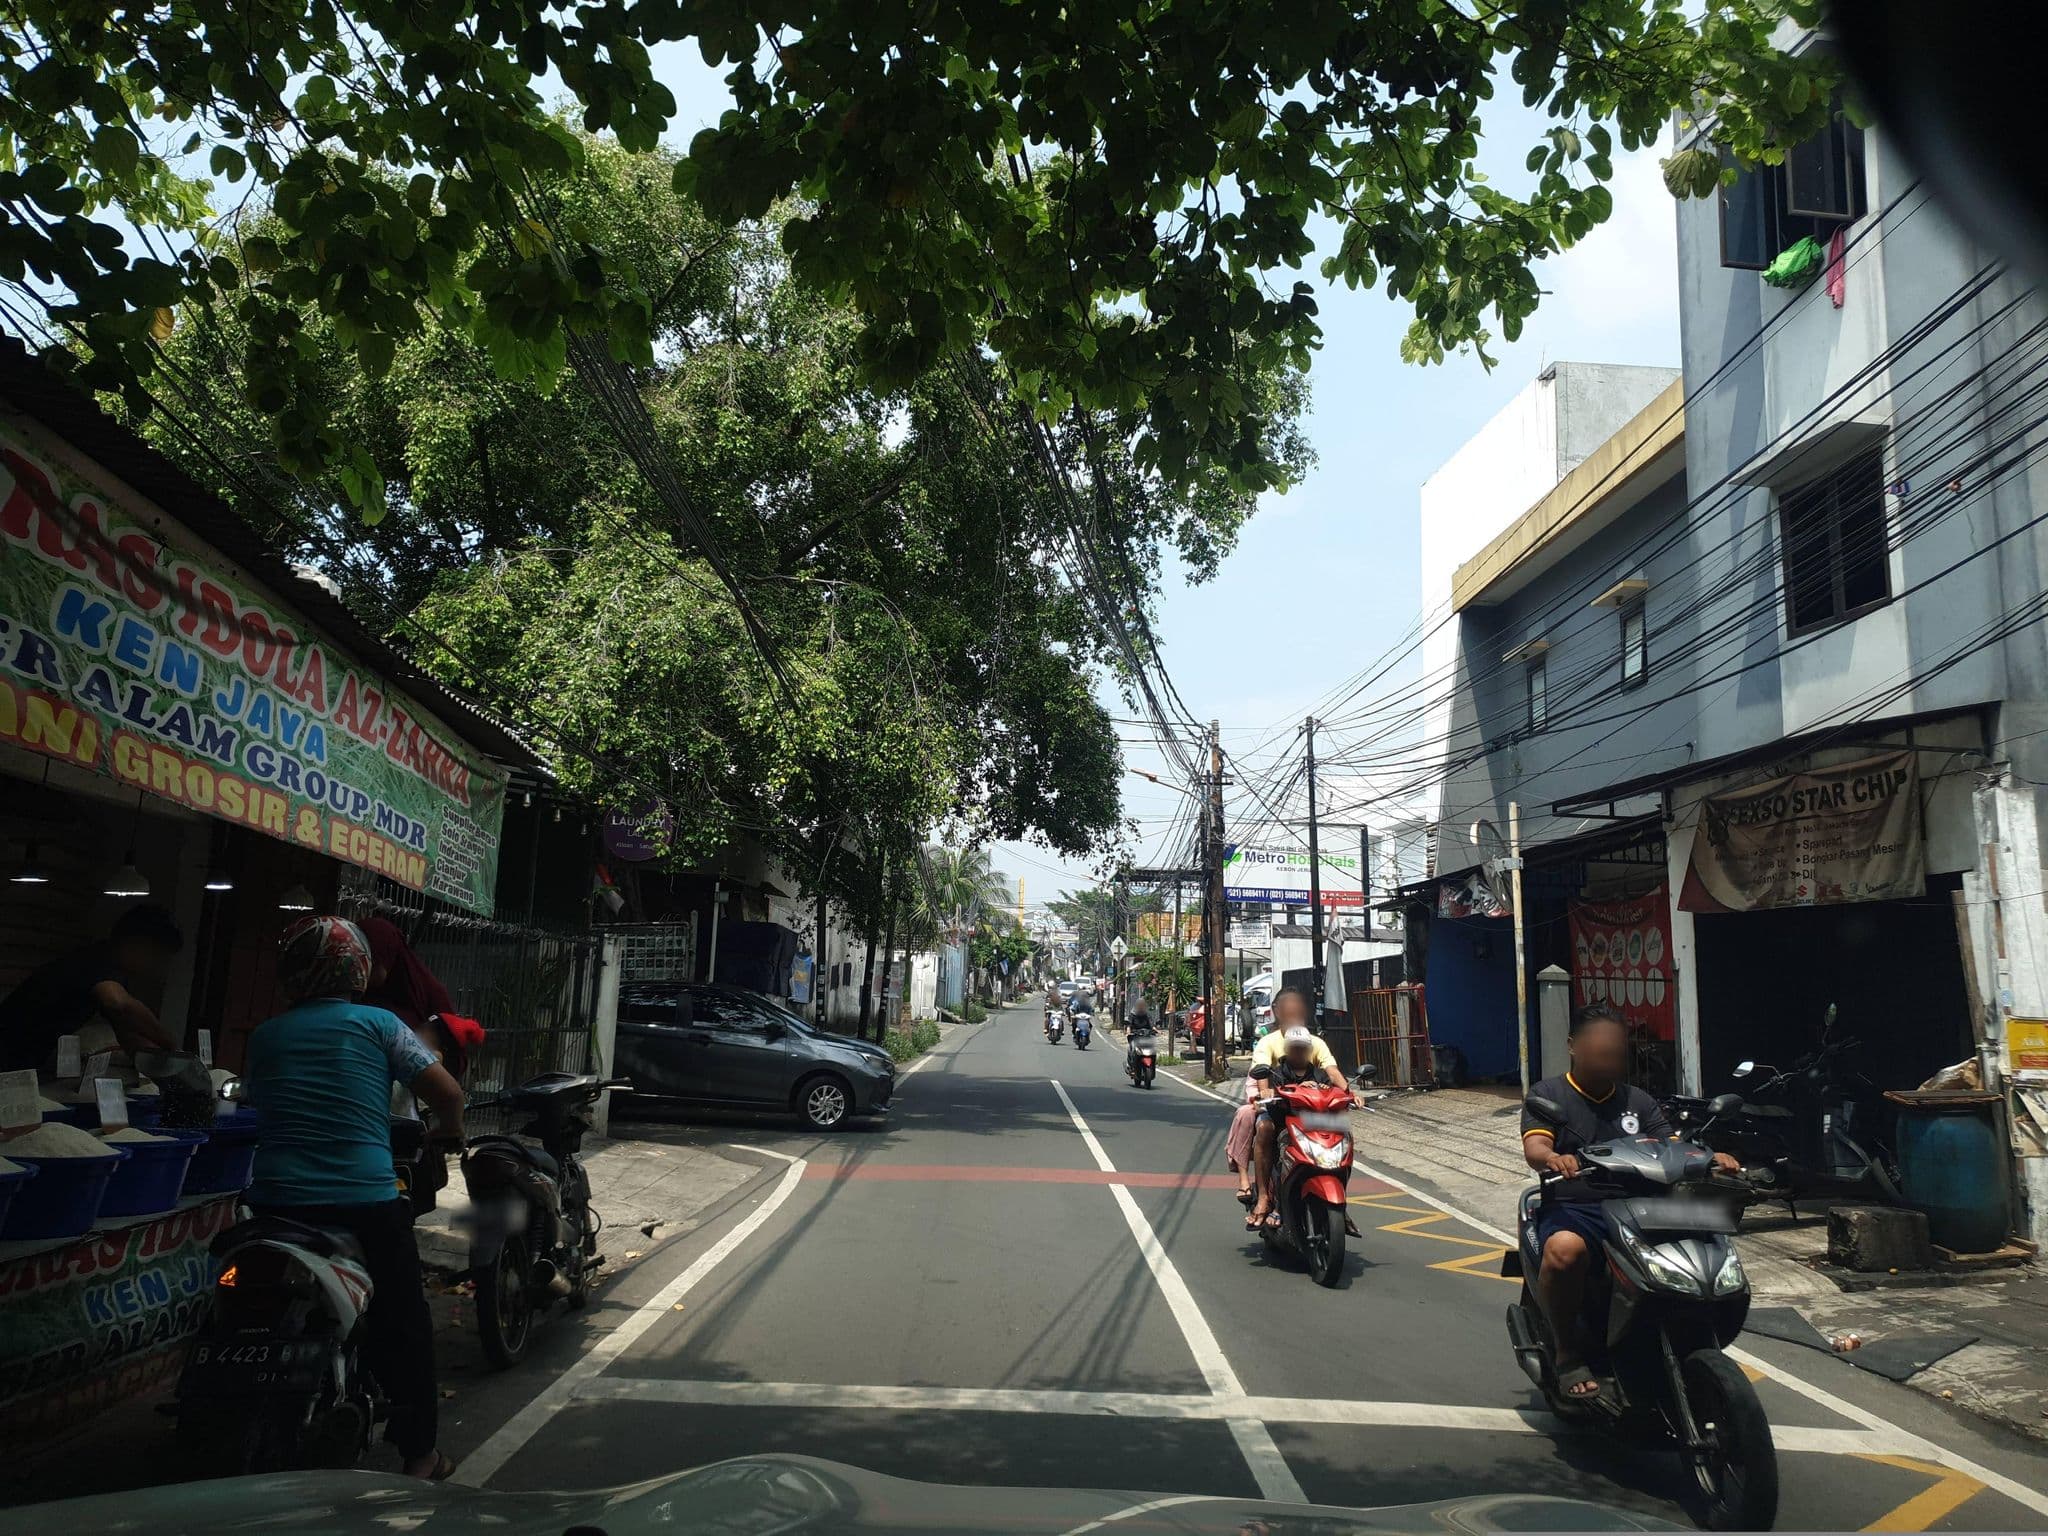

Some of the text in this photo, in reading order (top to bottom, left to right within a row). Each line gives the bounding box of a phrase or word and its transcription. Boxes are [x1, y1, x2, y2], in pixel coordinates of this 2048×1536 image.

[55, 588, 325, 762] KEN JAYA
[176, 567, 326, 714] IDOLA
[78, 667, 236, 763] ALAM
[246, 744, 369, 820] GROUP
[374, 802, 427, 850] MDR
[114, 735, 287, 834] GROSIR
[295, 808, 322, 847] &
[329, 821, 426, 887] ECERAN
[1792, 782, 1848, 816] STAR
[1852, 768, 1907, 802] CHIP
[84, 1268, 169, 1323] KEN
[216, 1345, 270, 1364] 4423
